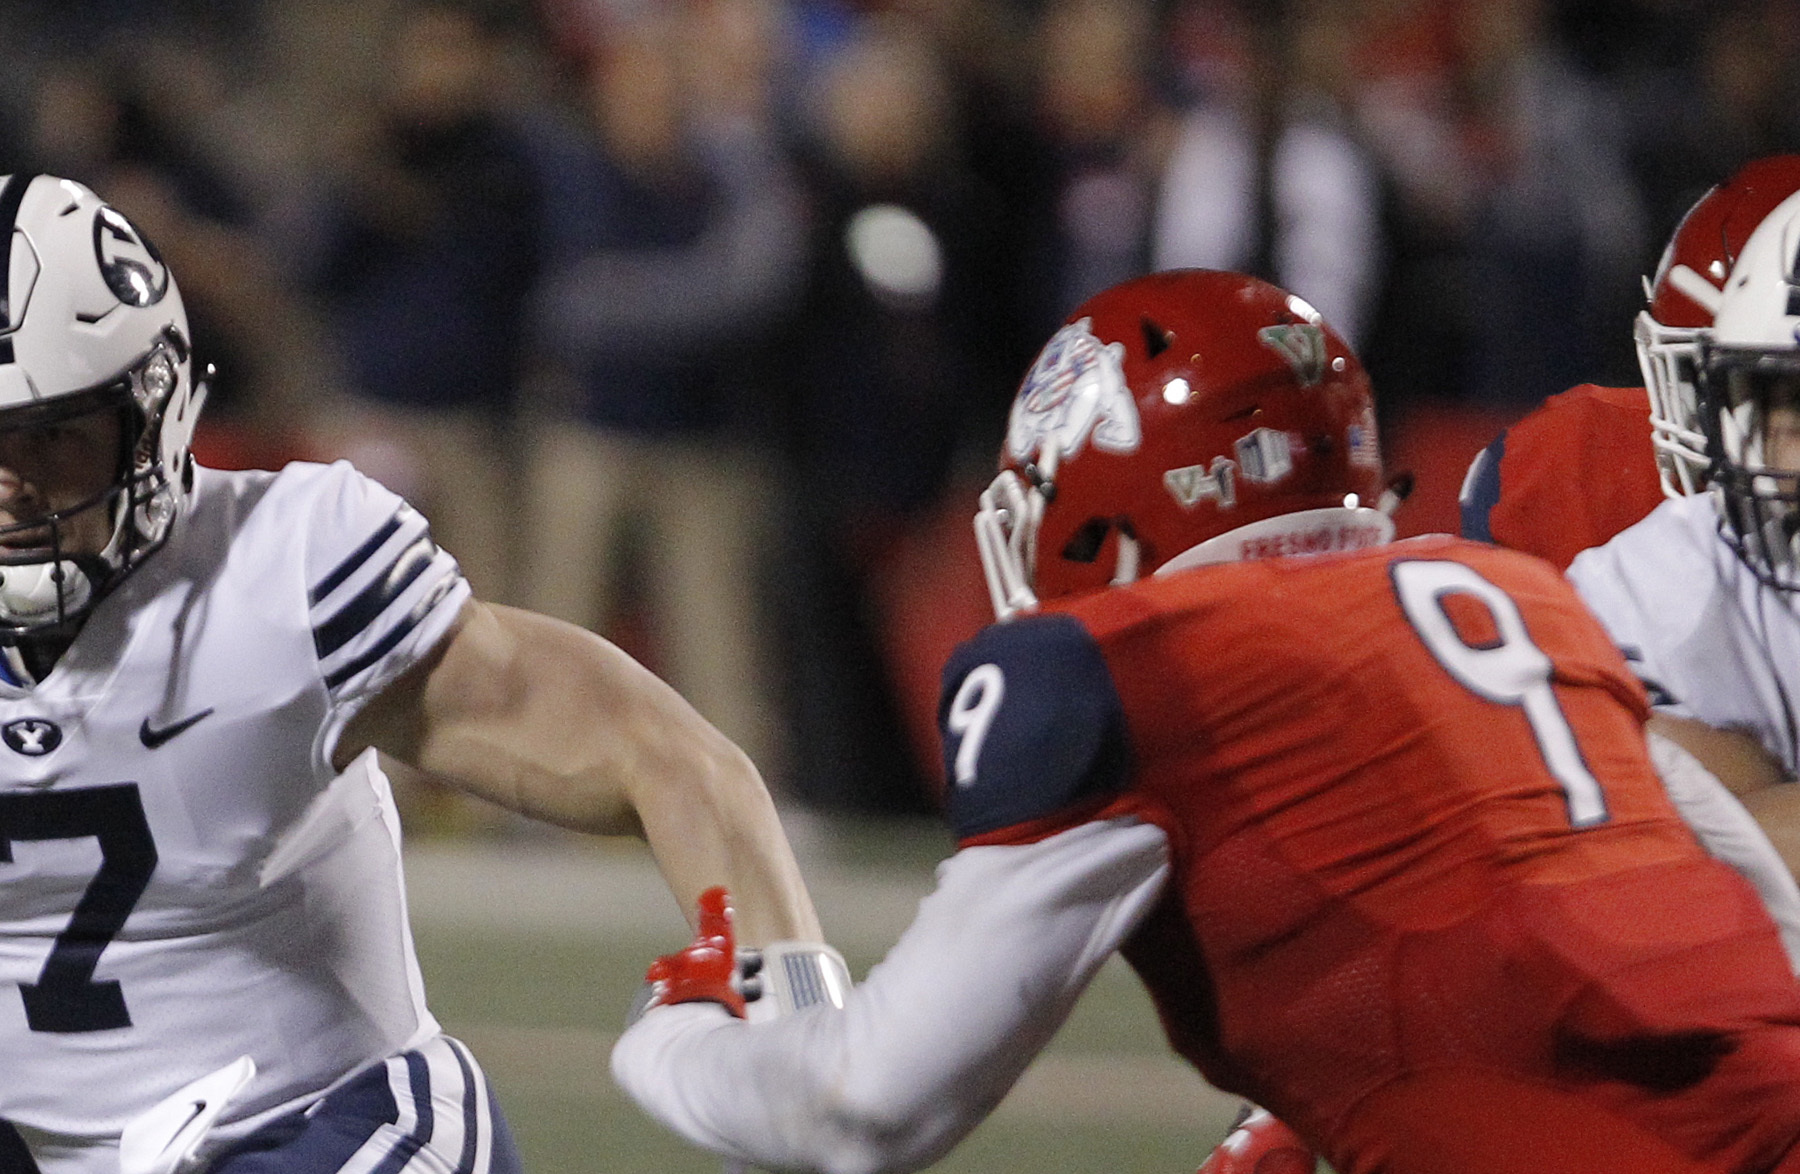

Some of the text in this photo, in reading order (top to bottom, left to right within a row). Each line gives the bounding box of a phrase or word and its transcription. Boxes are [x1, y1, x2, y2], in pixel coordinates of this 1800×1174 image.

[7, 720, 52, 753] Y
[948, 662, 1005, 787] 9
[1388, 557, 1609, 829] 9
